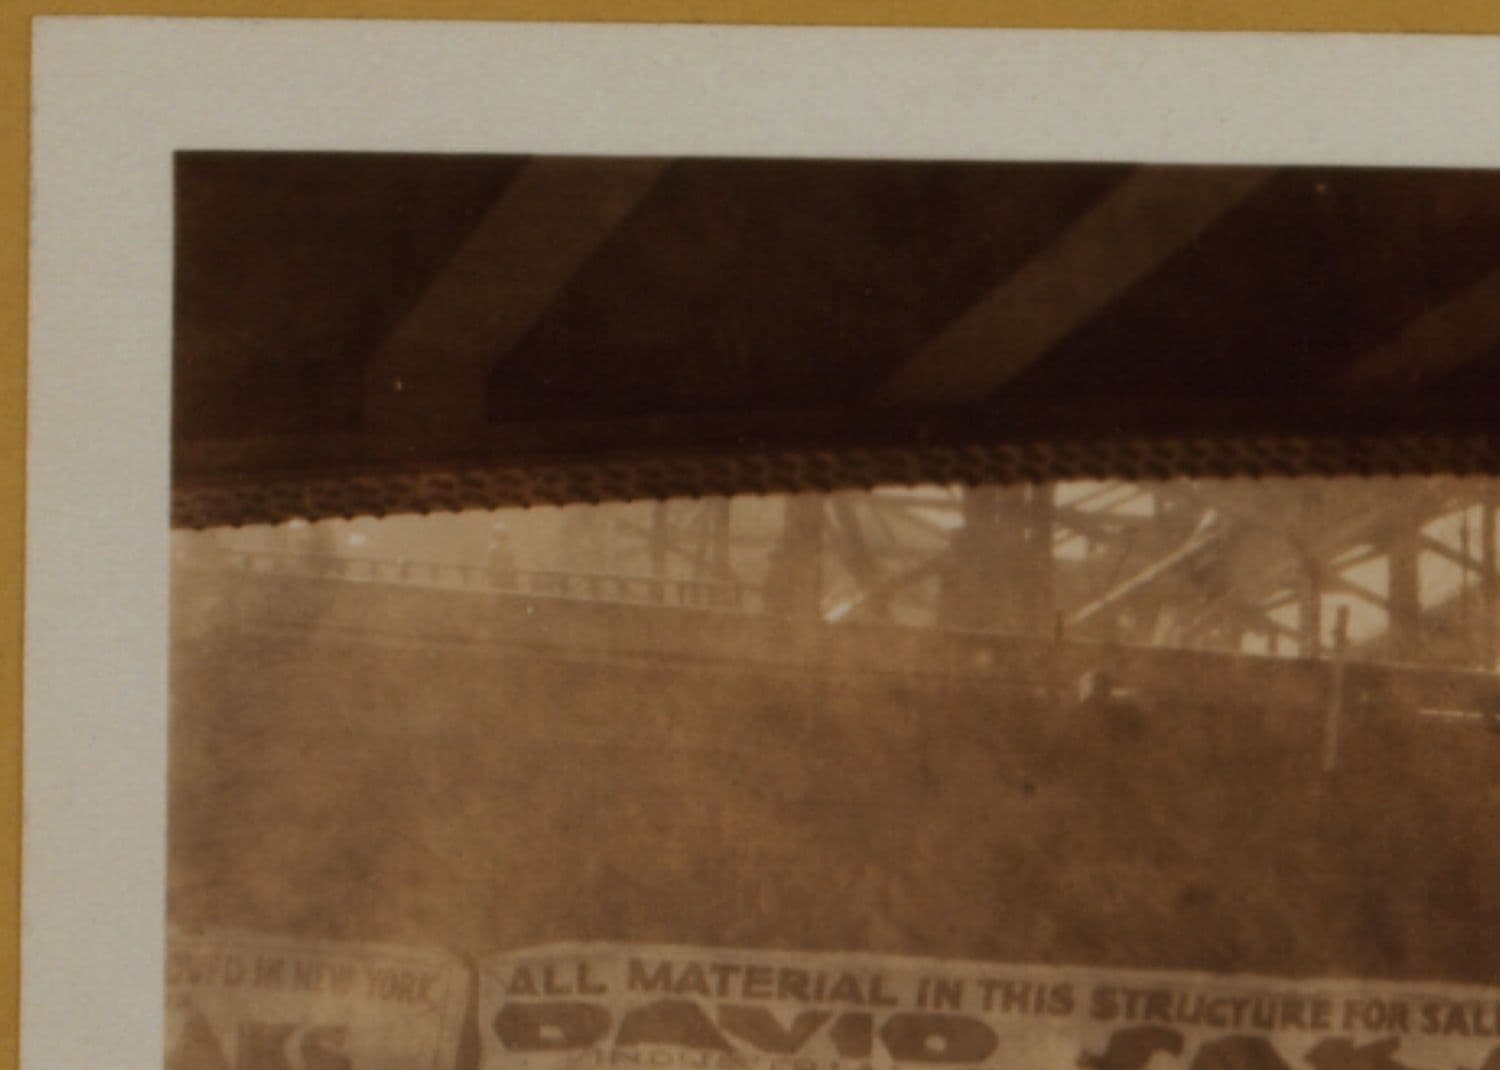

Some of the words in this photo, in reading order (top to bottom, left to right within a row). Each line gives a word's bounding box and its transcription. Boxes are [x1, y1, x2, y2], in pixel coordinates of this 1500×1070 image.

[505, 960, 608, 996] ALL
[627, 957, 899, 1006] MATERIAL
[915, 977, 964, 1010] IN
[977, 979, 1076, 1017] THIS
[1090, 985, 1331, 1032] STRUCTURE
[1342, 999, 1411, 1032] FOR
[493, 998, 1000, 1065] DAVID
